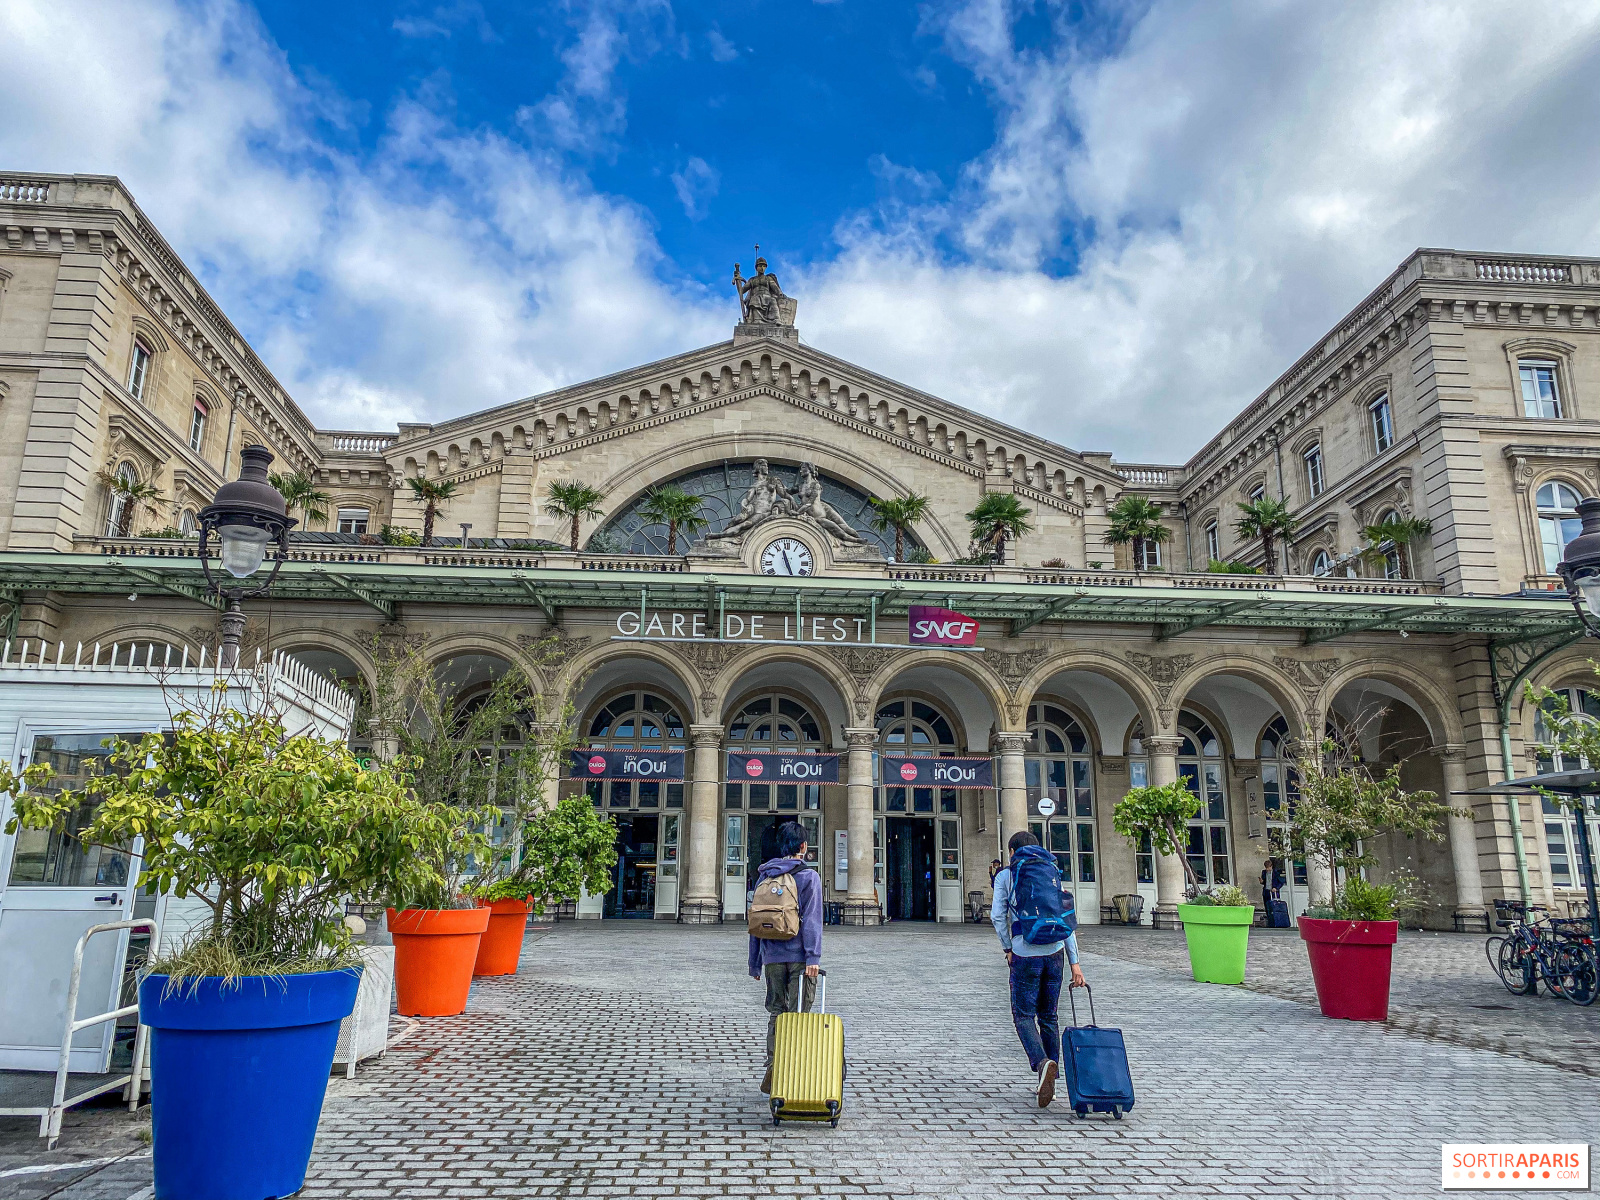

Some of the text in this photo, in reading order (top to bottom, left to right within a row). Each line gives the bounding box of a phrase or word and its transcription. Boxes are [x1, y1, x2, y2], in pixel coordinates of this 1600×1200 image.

[616, 611, 867, 642] GARE DE L'EST
[912, 620, 976, 640] SNCF
